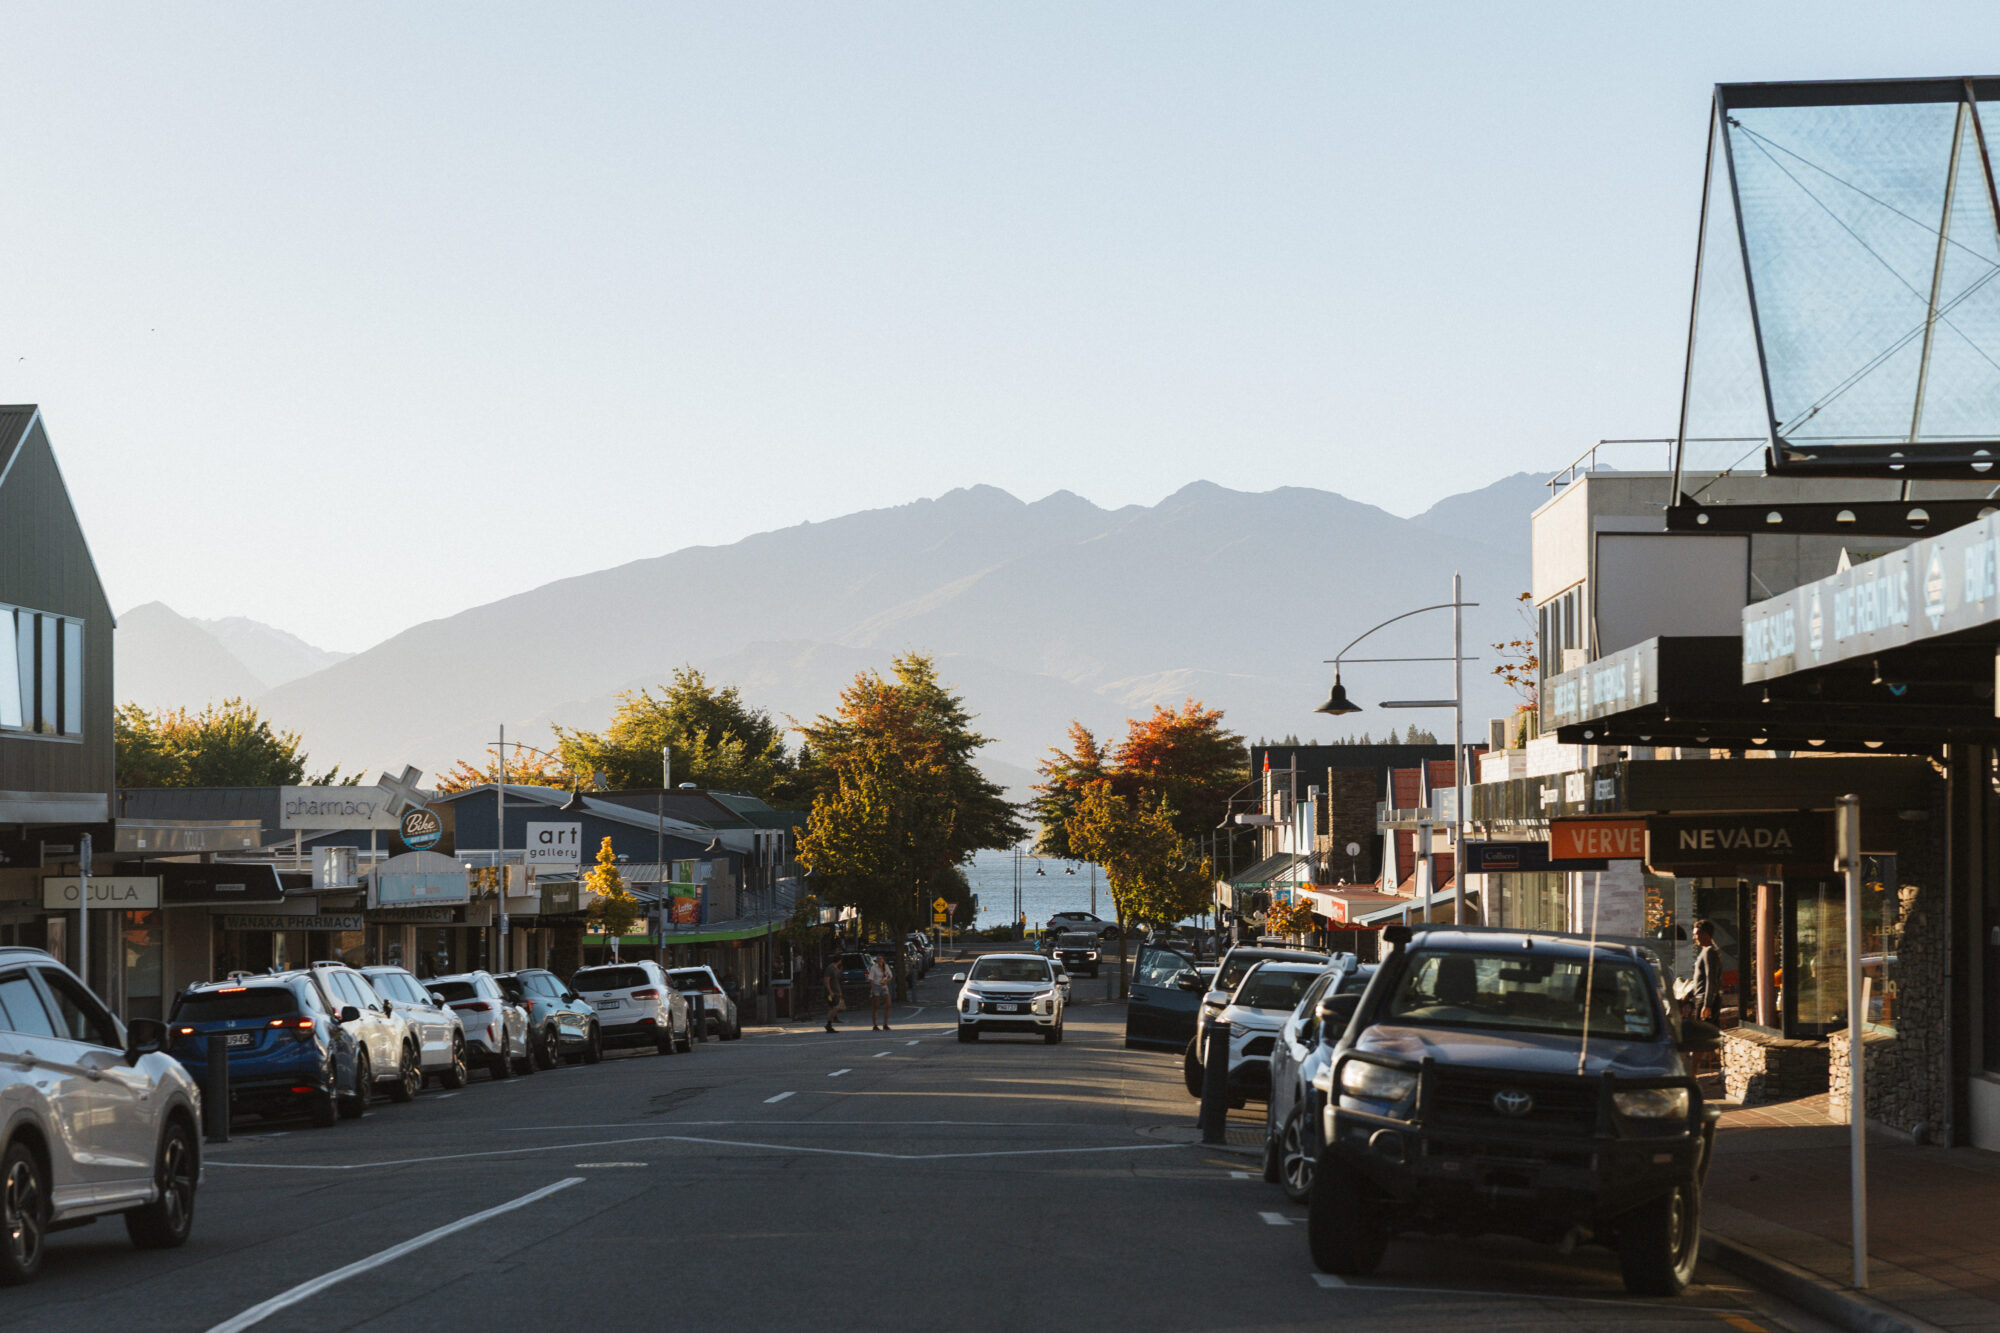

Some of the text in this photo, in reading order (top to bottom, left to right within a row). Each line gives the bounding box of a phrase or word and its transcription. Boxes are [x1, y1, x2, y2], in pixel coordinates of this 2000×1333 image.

[1855, 570, 1910, 634] RENTALS
[285, 796, 377, 820] pharmacy
[406, 813, 436, 833] Bike
[539, 827, 577, 844] art
[1571, 827, 1641, 854] VERVE
[1679, 827, 1793, 850] NEVADA
[529, 848, 577, 859] gallery
[227, 916, 284, 929] WANAKA
[287, 916, 361, 929] PHARMACY
